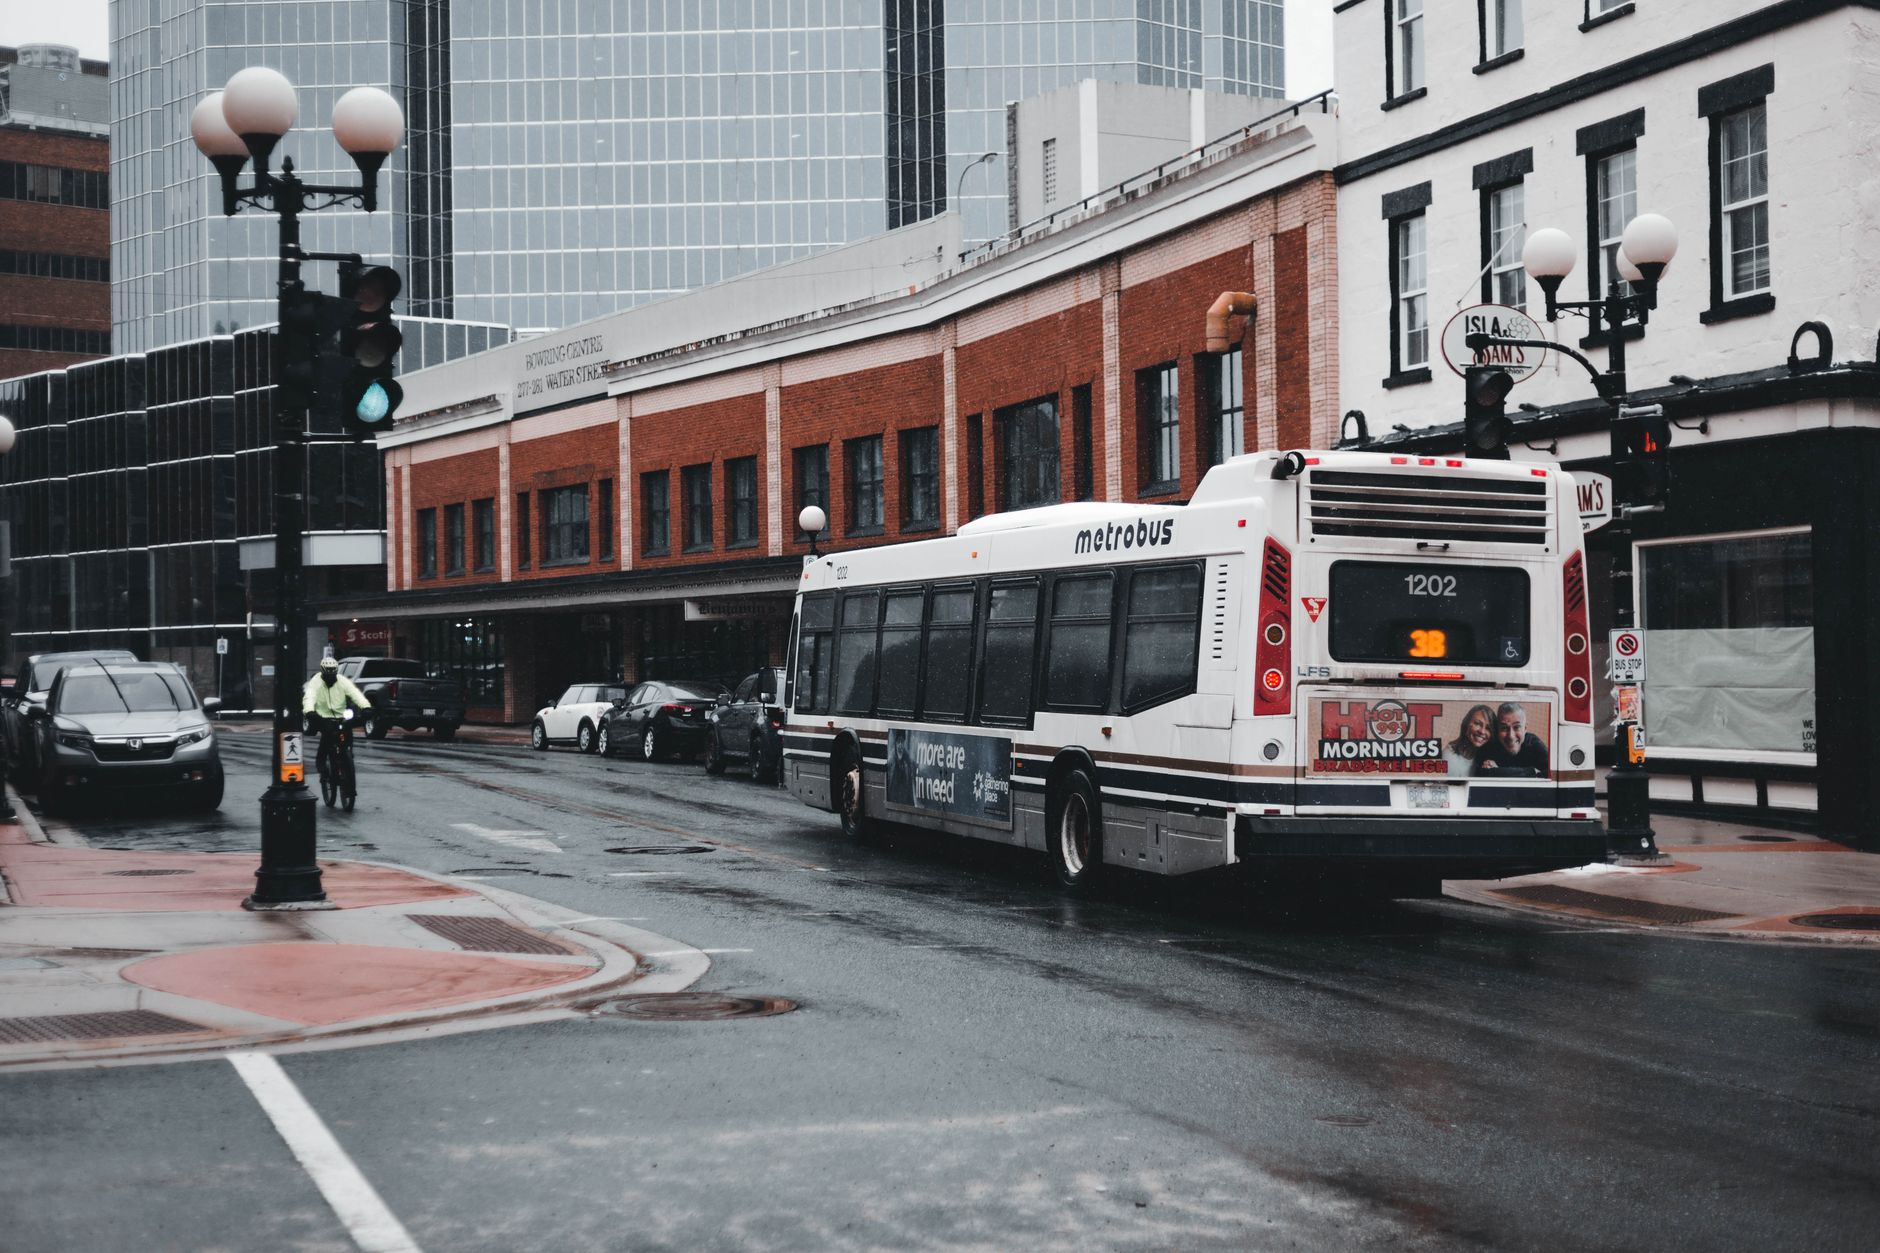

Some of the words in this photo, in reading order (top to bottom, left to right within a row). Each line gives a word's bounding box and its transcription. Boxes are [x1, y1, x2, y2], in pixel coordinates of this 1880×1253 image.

[525, 345, 566, 371] BOWRING
[566, 335, 603, 360] CENTRE
[517, 378, 543, 398] 277-281
[545, 368, 574, 391] WATER
[1074, 517, 1175, 555] metrobus
[1404, 574, 1457, 597] 1202
[1297, 666, 1331, 677] LFS
[1615, 659, 1626, 670] BUS
[1628, 658, 1642, 670] STOP
[1802, 719, 1814, 729] WE
[1802, 731, 1816, 740] LOV
[917, 742, 945, 767] more
[946, 745, 965, 770] are
[1323, 740, 1439, 759] MORNINGS
[915, 769, 925, 799] in
[926, 772, 954, 804] need
[984, 778, 1008, 795] gathering
[985, 789, 998, 803] place
